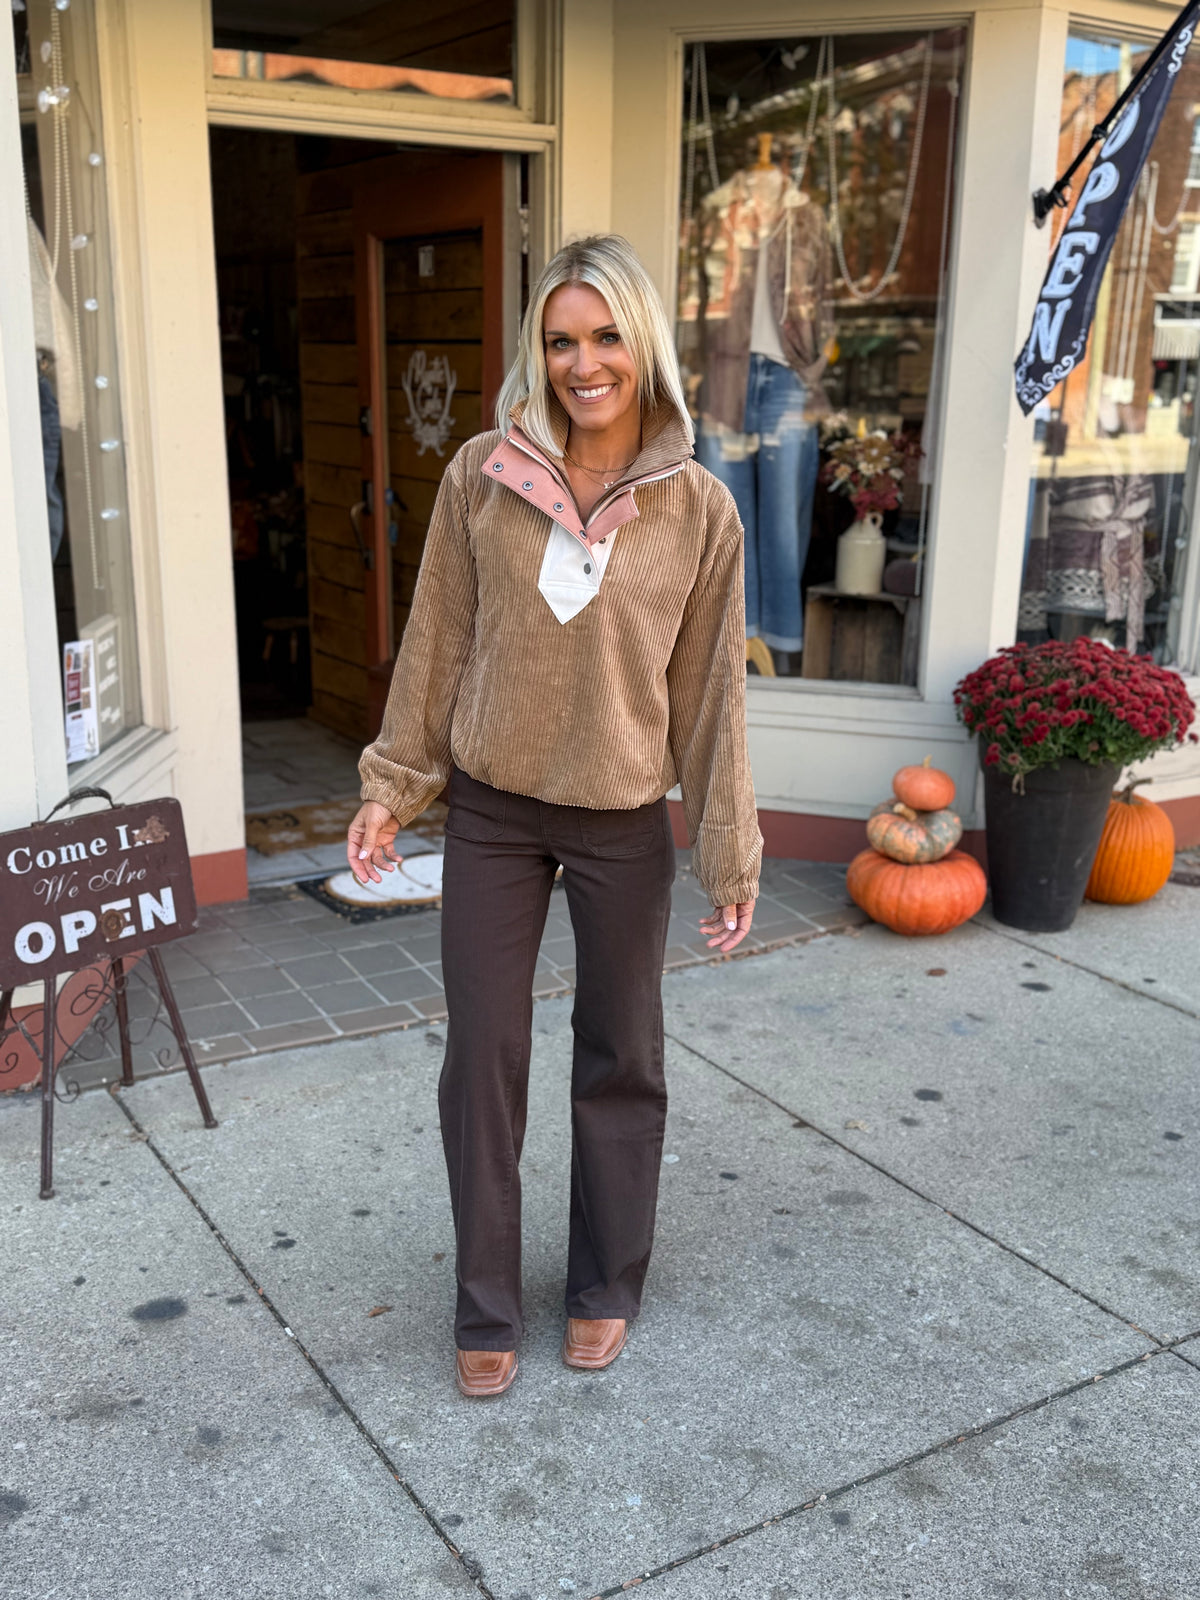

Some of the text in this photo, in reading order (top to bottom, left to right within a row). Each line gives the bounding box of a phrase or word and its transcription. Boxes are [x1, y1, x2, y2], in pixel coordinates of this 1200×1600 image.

[1028, 98, 1140, 363] OPEN
[7, 837, 108, 875] Come
[33, 858, 147, 906] We Are
[14, 886, 177, 964] OPEN
